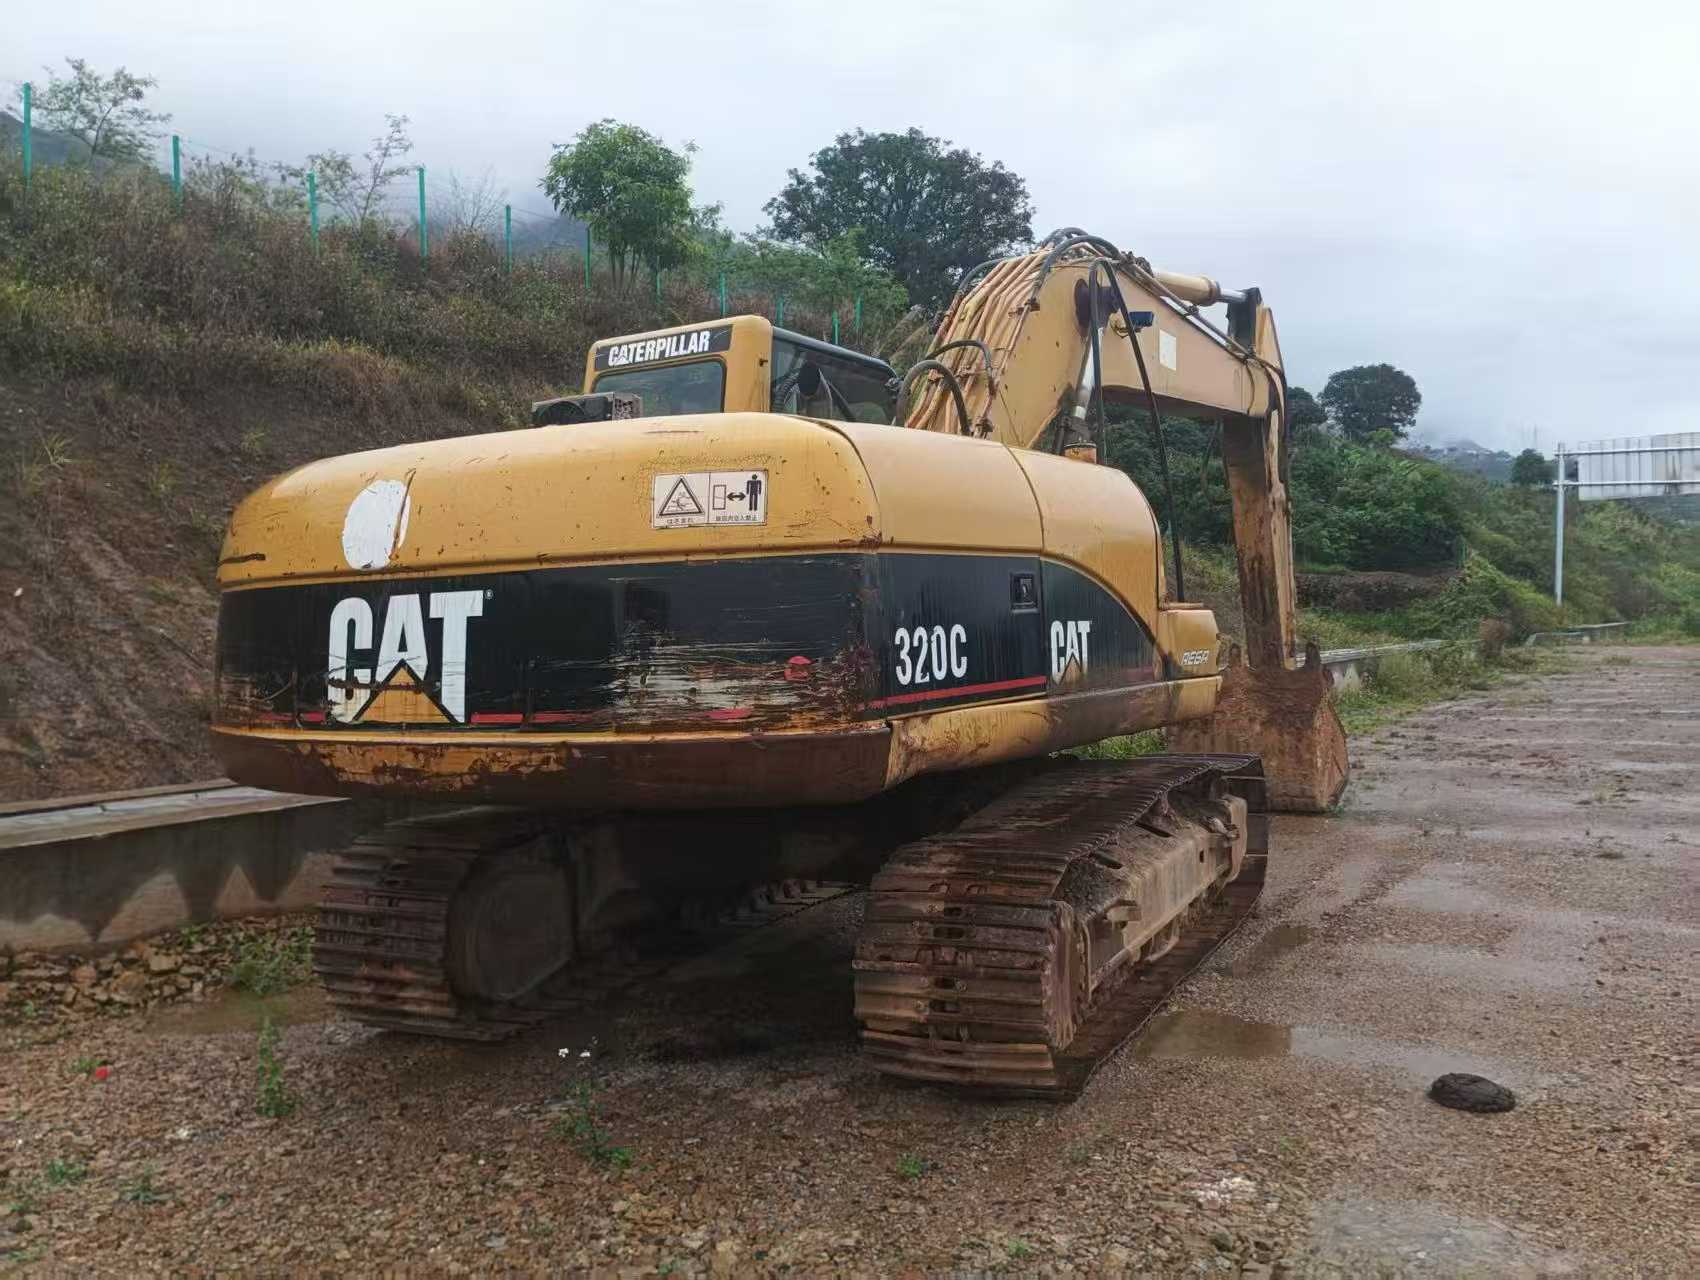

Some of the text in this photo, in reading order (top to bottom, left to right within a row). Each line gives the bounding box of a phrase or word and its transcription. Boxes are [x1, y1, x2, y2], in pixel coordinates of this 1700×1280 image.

[608, 331, 711, 366] CATERPILLAR
[328, 590, 484, 724] CAT
[895, 624, 967, 685] 320C
[1050, 620, 1091, 685] CAT
